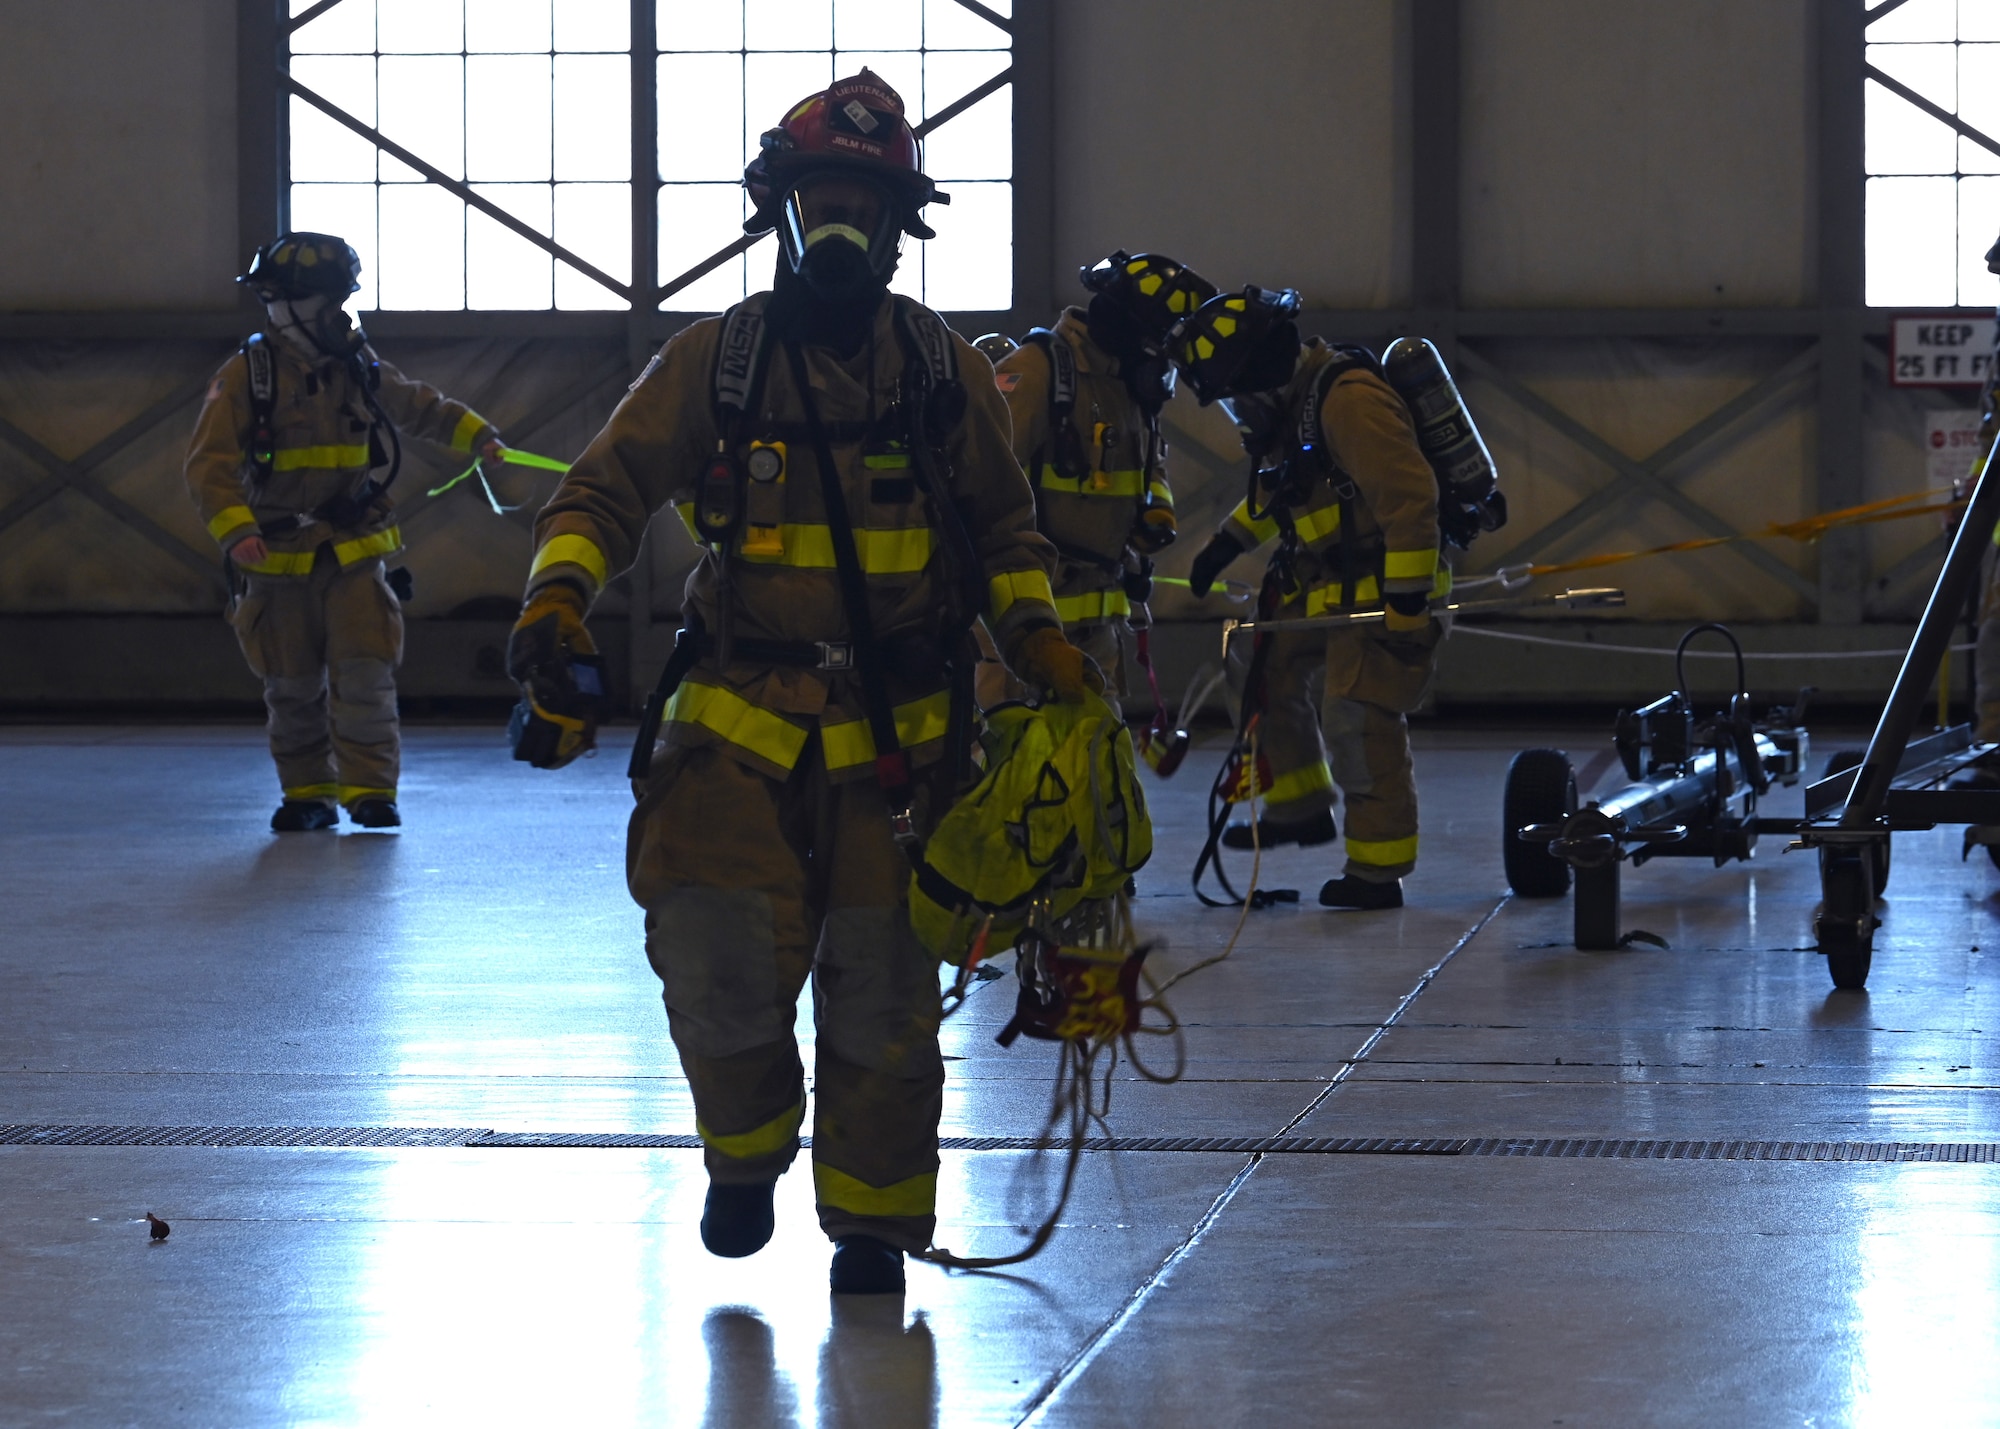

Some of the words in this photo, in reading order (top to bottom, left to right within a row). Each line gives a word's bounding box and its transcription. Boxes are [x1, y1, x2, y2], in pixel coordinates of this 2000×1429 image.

[832, 136, 859, 149] JBLM
[861, 143, 883, 156] FIRE
[724, 313, 759, 377] MSA
[1918, 325, 1973, 346] KEEP
[1898, 356, 1925, 377] 25
[1934, 356, 1959, 377] FT
[1950, 430, 1979, 448] STO
